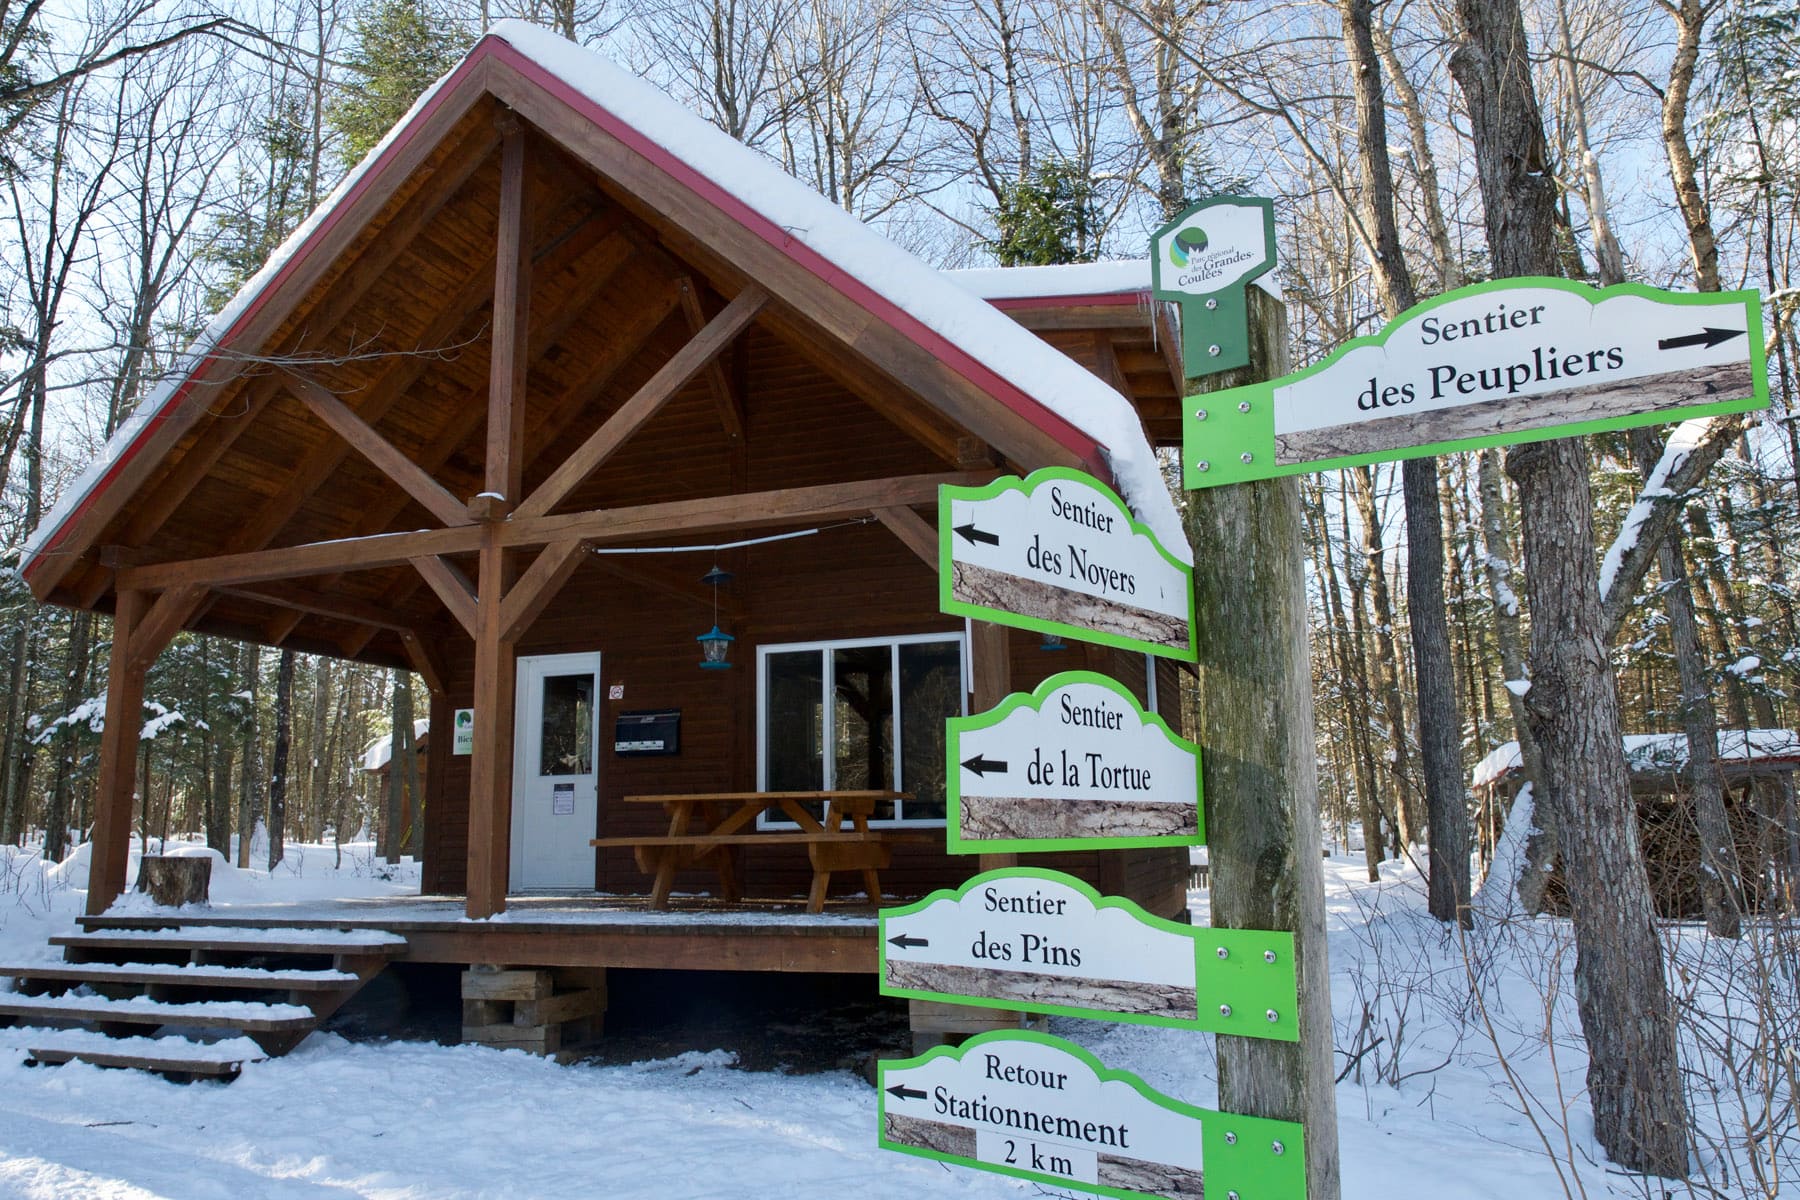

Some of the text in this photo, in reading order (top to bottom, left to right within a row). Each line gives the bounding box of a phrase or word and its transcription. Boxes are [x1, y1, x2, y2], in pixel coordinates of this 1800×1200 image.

[1191, 246, 1235, 265] Parc régional
[1191, 263, 1202, 273] des
[1178, 268, 1223, 287] Coulées
[1421, 304, 1545, 345] Sentier
[1357, 346, 1624, 411] des Peupliers
[1051, 486, 1113, 534] Sentier
[1026, 534, 1136, 595] des Noyers
[1061, 693, 1123, 730] Sentier
[1027, 747, 1151, 790] de la Tortue
[984, 887, 1066, 916] Sentier
[971, 931, 1081, 968] des Pins
[984, 1053, 1067, 1090] Retour
[934, 1085, 1130, 1148] Stationnement
[1004, 1140, 1074, 1177] 2 km
